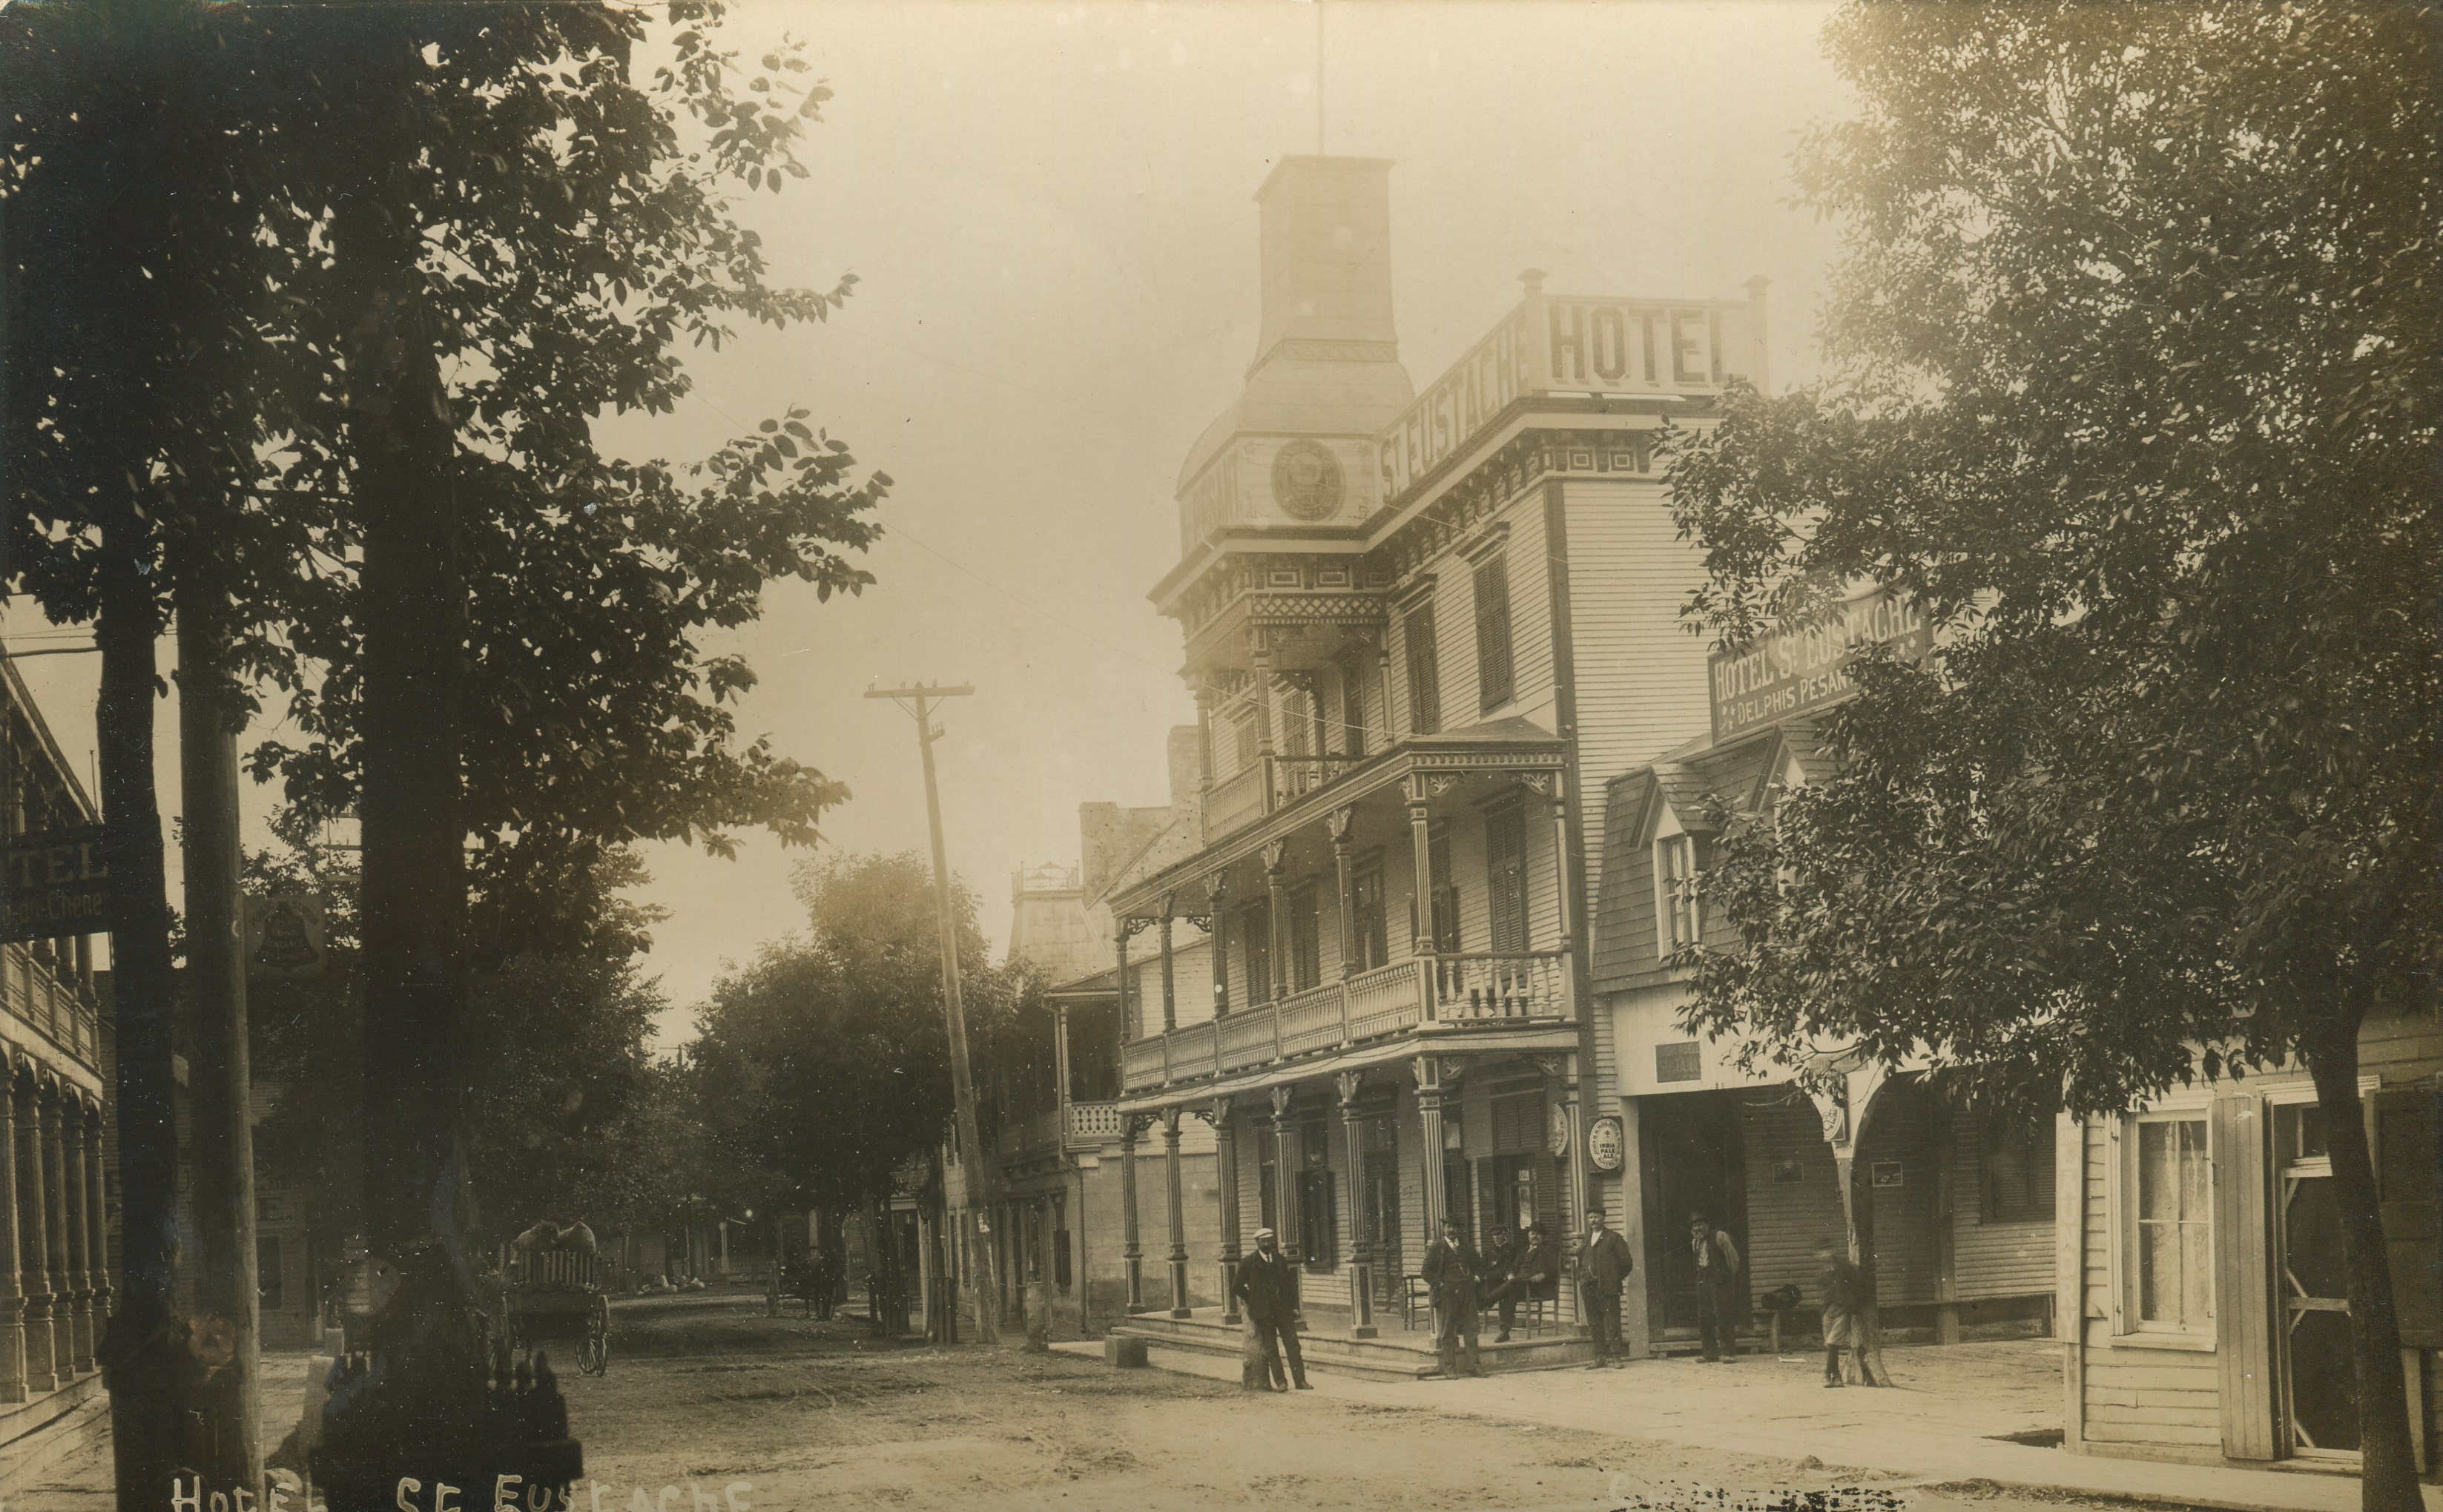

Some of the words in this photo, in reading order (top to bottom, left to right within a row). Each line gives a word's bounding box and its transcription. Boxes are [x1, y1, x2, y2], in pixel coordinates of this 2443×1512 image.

[1407, 313, 1530, 486] EUSTACHE
[1549, 305, 1744, 385] HOTEL
[1715, 649, 1774, 704] HOTEL
[1806, 591, 1922, 670] EUSTACHE
[1738, 689, 1796, 724] DELPHIS
[2059, 1146, 2080, 1342] LAUNDRY
